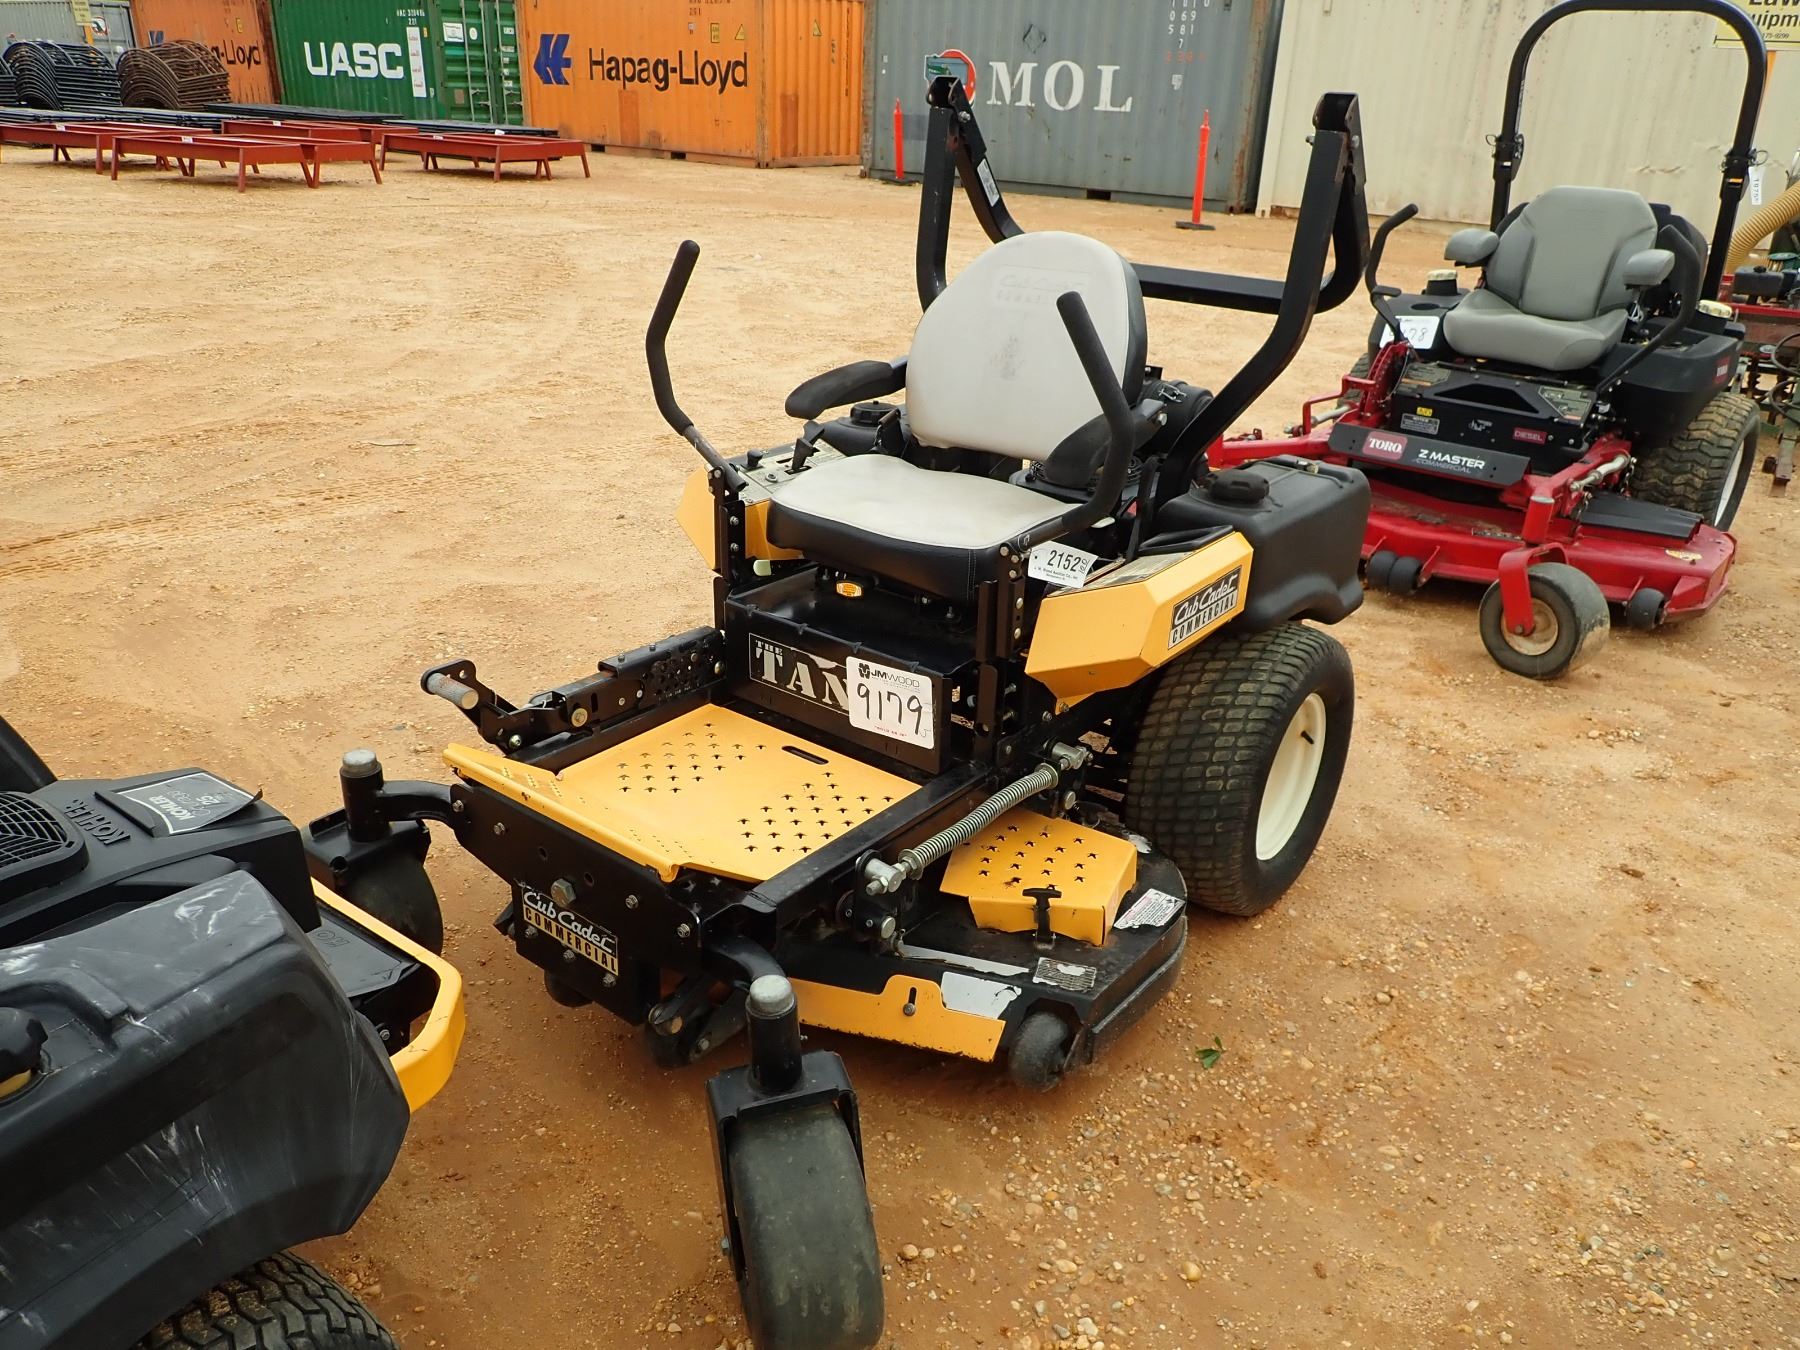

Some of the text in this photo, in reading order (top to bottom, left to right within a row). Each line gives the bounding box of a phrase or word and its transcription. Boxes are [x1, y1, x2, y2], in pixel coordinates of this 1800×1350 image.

[304, 41, 404, 79] UASC
[589, 48, 748, 95] Hapag-Lloyd
[986, 59, 1133, 113] MOL
[1369, 437, 1403, 454] TORO
[1418, 449, 1486, 470] Z MASTER
[1514, 430, 1544, 442] DIESEL
[1414, 458, 1472, 474] COMMERCIAL
[1047, 549, 1082, 572] 2152
[1172, 592, 1235, 644] COMMERCIAL
[1174, 573, 1239, 626] Cub Cadet
[755, 639, 783, 655] THE
[755, 646, 848, 711] TAN
[857, 682, 923, 735] 9179
[64, 799, 131, 846] KOHLER
[149, 794, 196, 821] KOHLER
[524, 891, 615, 953] Cub Cadet
[525, 907, 618, 972] COMMERCIAL
